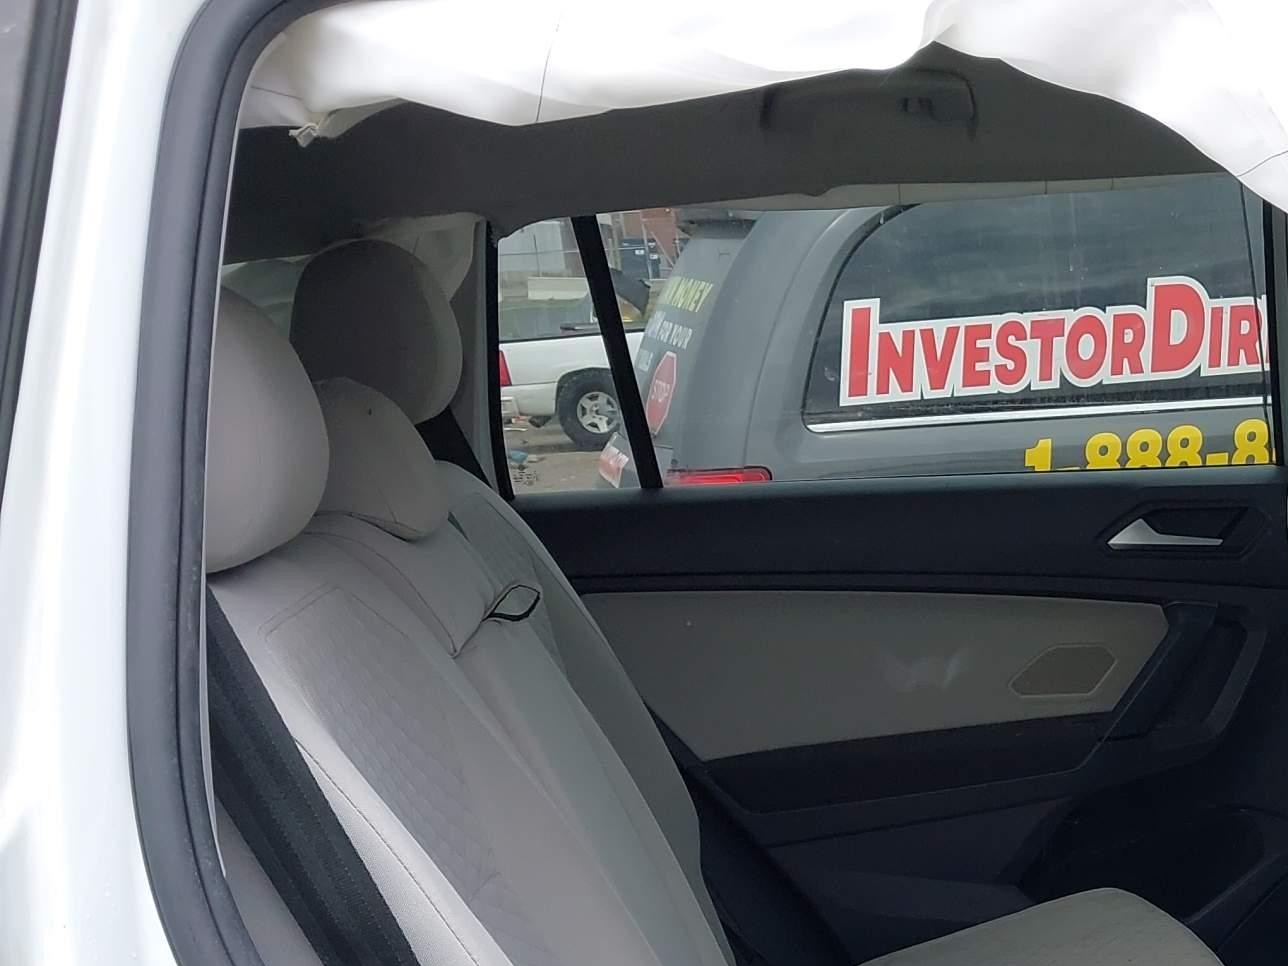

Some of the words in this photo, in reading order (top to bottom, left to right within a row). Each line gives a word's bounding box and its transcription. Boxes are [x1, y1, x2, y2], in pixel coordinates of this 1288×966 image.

[671, 277, 714, 313] MONEY
[847, 282, 1269, 398] INVESTORDIR
[1024, 418, 1277, 472] 1888-8
